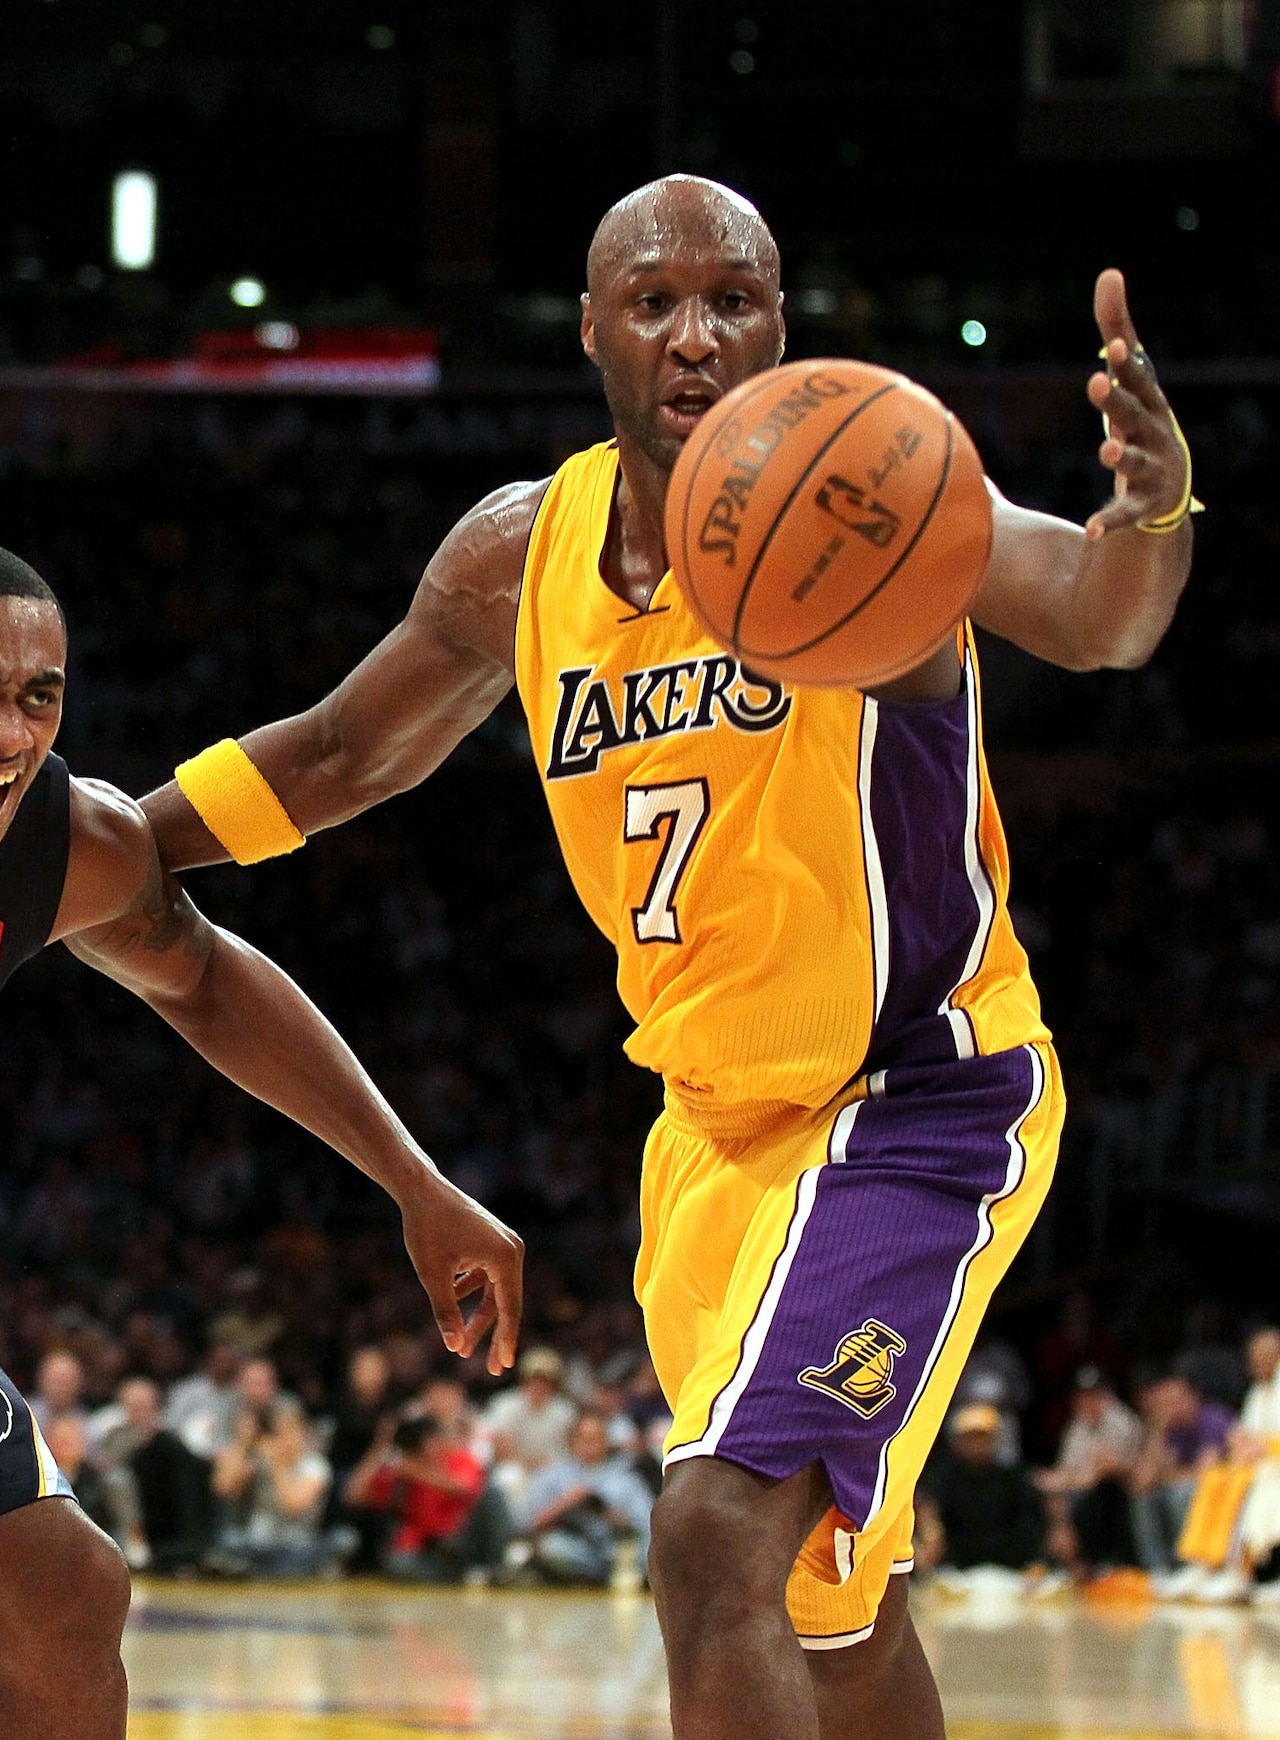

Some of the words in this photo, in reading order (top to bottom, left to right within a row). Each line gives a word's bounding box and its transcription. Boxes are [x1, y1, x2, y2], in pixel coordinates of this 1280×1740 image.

[698, 371, 852, 566] SPALDING
[545, 652, 792, 781] LAKERS
[624, 777, 710, 944] 7
